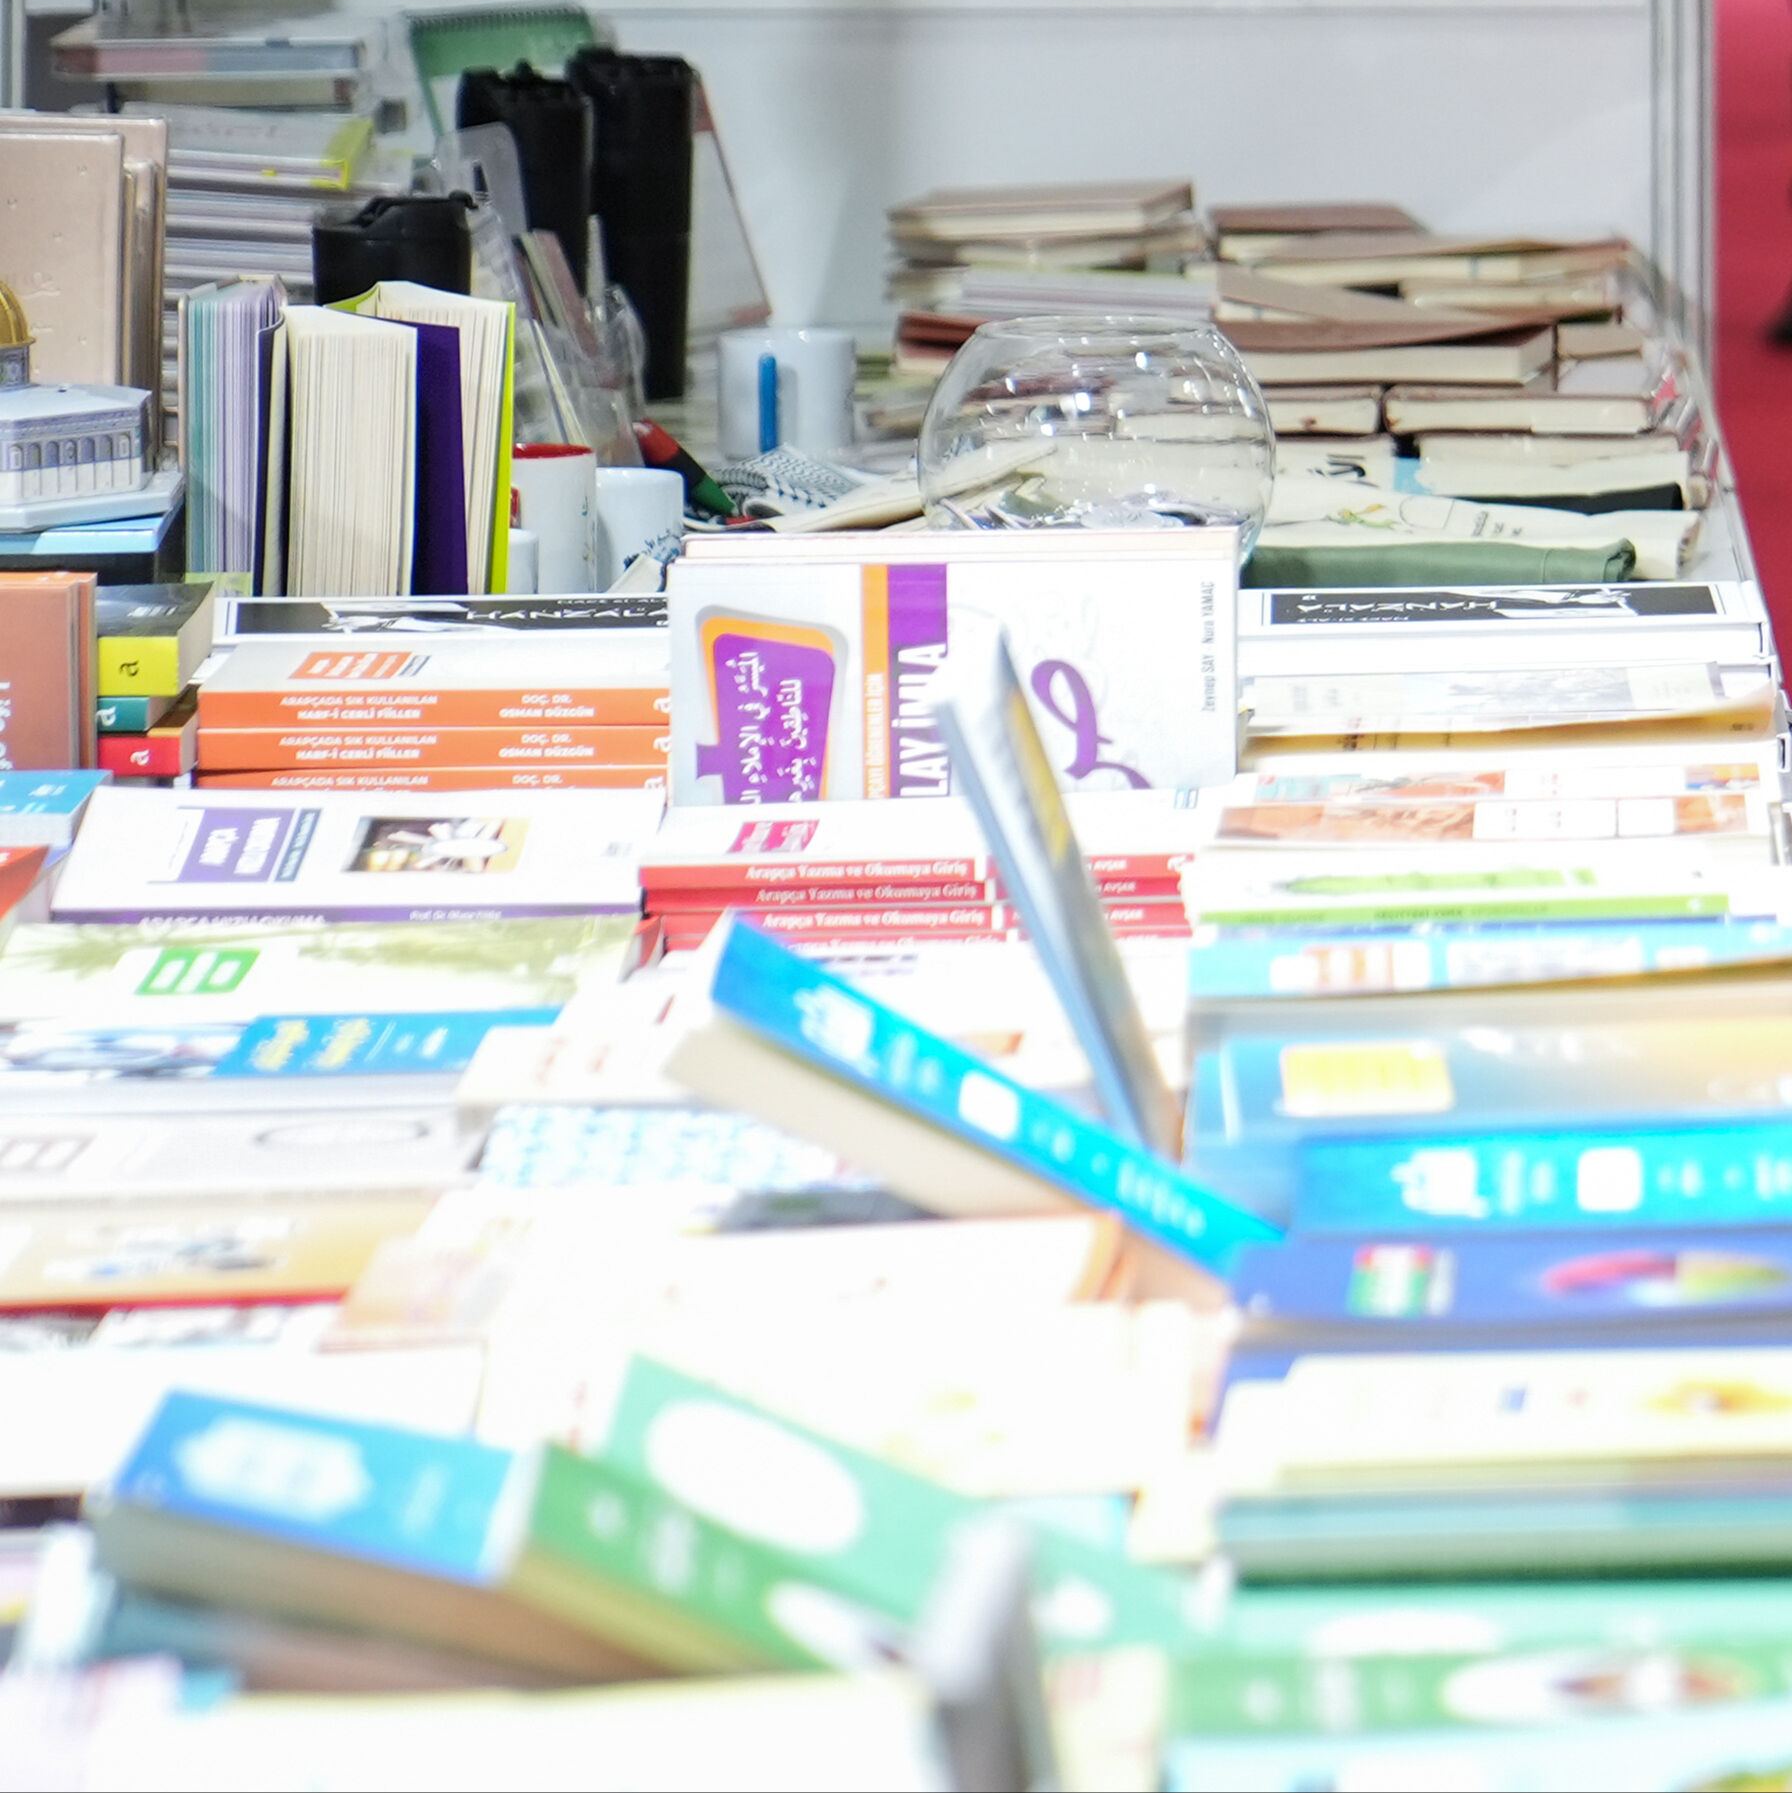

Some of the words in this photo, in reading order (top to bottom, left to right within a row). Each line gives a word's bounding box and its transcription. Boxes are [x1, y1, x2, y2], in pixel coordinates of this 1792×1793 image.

[280, 696, 343, 706] ARAPÇADA
[345, 696, 364, 705] SIK
[366, 695, 438, 705] KULLANILAN
[521, 694, 550, 705] DOÇ.
[551, 694, 573, 703] DR.
[499, 708, 543, 718] OSMAN
[544, 705, 595, 717] DÜZGÜN
[279, 736, 342, 747] ARAPÇADA
[344, 736, 364, 745] SIK
[365, 735, 438, 745] KULLANILAN
[521, 733, 550, 745] DOÇ.
[551, 733, 572, 743] DR.
[499, 747, 543, 757] OSMAN
[544, 745, 595, 757] DÜZGÜN
[271, 776, 334, 788] ARAPÇADA
[336, 776, 355, 786] SIK
[357, 775, 430, 785] KULLANILAN
[746, 866, 796, 882] Arapça
[798, 864, 845, 879] Yazma
[846, 866, 863, 877] ve
[864, 862, 932, 878] Okumaya
[932, 860, 968, 877] Giriş
[756, 889, 806, 905] Arapça
[808, 887, 855, 900] Yazma
[857, 888, 873, 899] ve
[875, 885, 941, 901] Okumaya
[942, 883, 978, 899] Giriş
[762, 914, 814, 929] Arapça
[815, 912, 862, 926] Yazma
[863, 913, 880, 924] ve
[881, 910, 948, 927] Okumaya
[949, 909, 985, 925] Giriş
